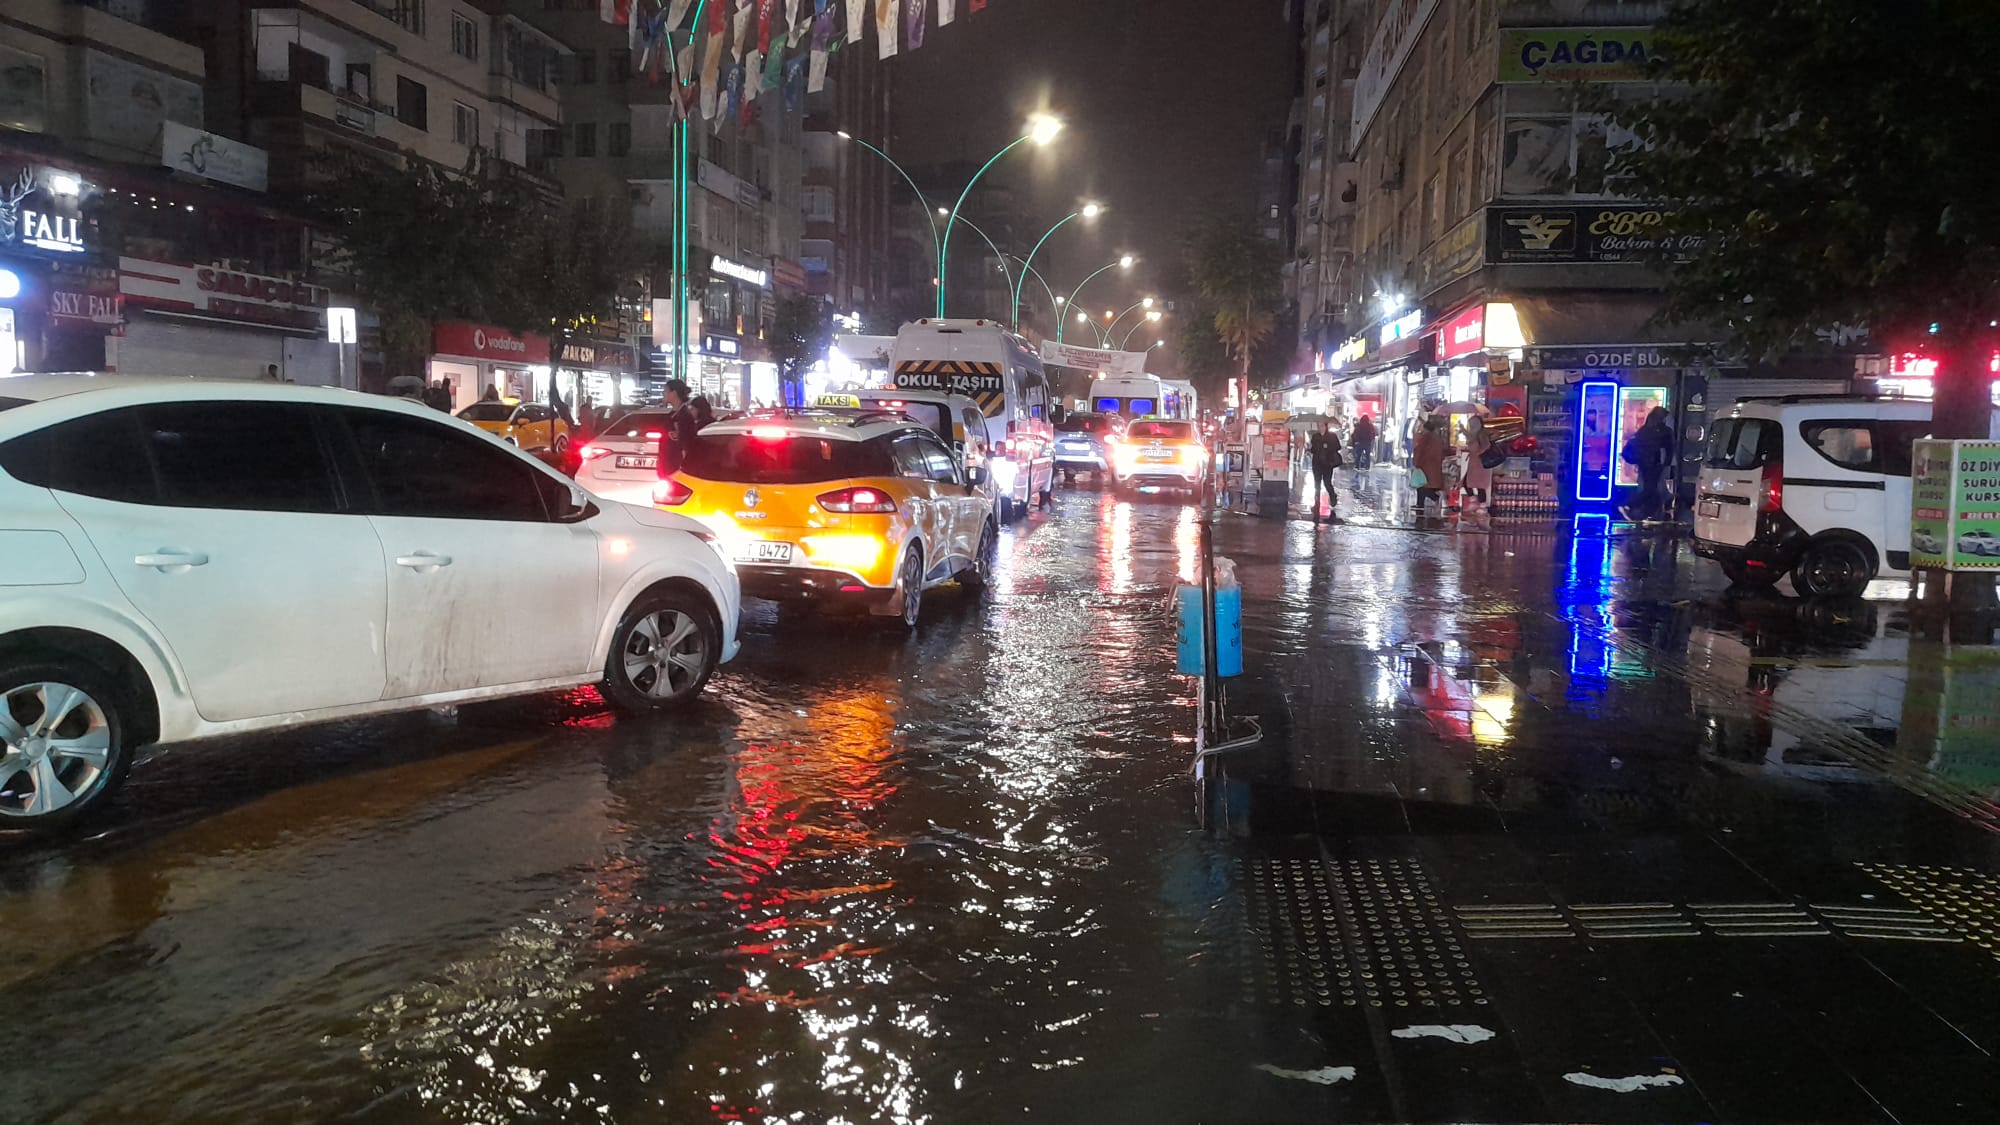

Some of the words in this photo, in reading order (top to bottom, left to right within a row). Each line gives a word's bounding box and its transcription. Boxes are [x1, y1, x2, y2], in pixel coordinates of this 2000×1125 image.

[23, 210, 84, 245] FALL
[52, 290, 83, 315] SKY
[88, 294, 124, 320] FALL
[1584, 351, 1632, 367] ÖZDE
[897, 373, 943, 388] OKUL
[951, 374, 1000, 391] TAŞITI
[759, 543, 789, 560] 0472
